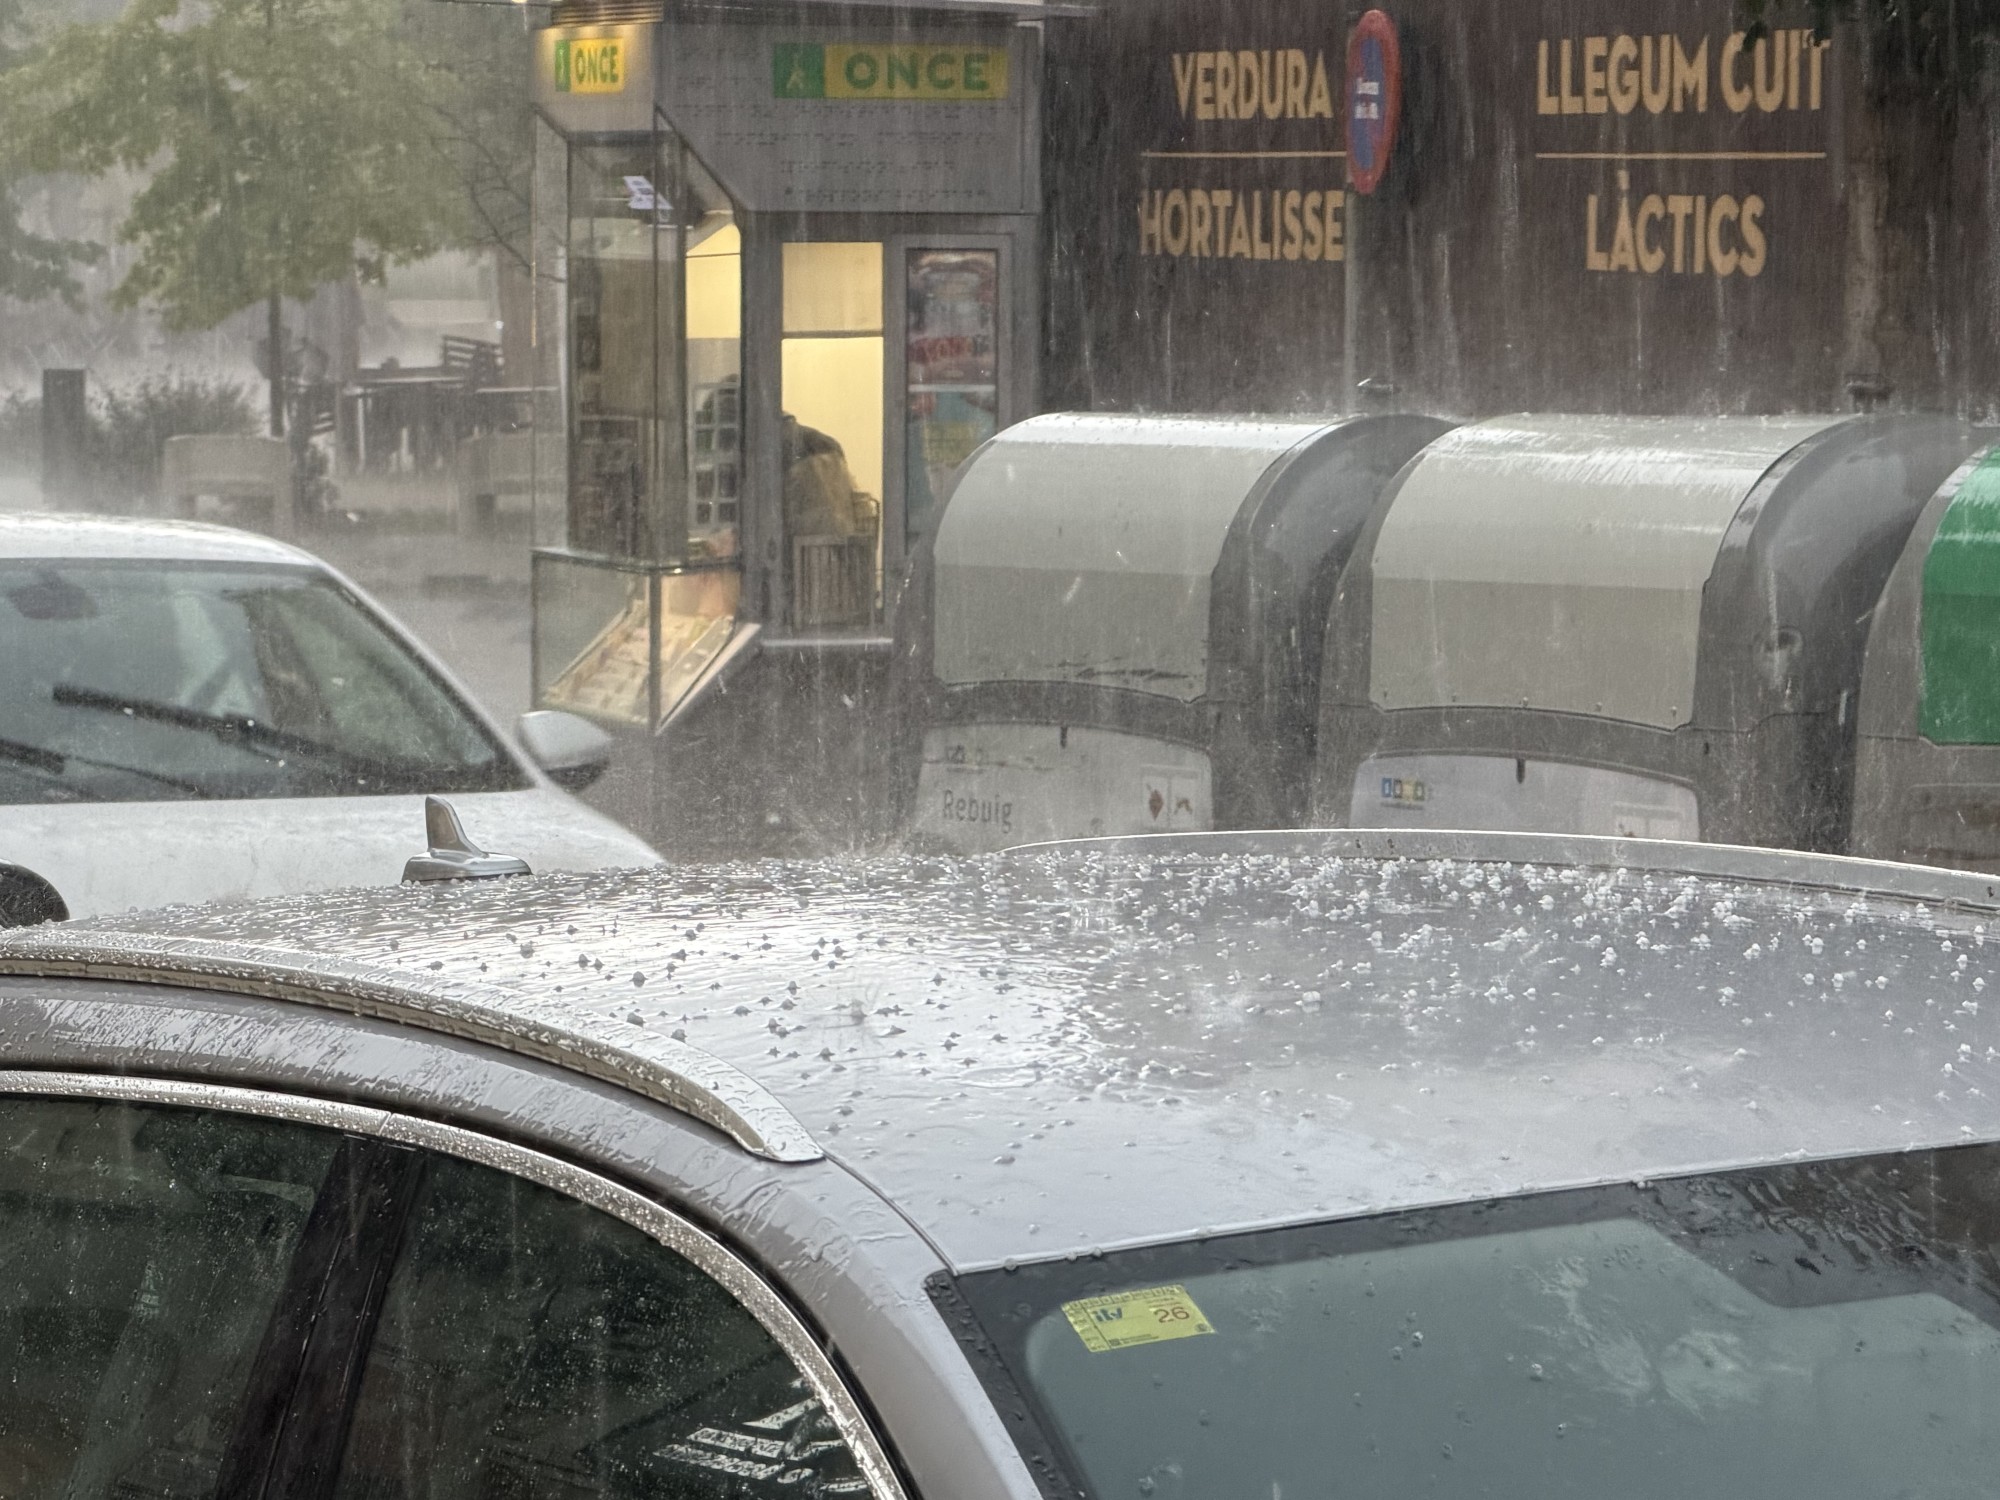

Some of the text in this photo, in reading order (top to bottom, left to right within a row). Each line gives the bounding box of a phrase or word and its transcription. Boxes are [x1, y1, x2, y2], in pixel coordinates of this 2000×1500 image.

[574, 46, 619, 84] ONCE
[845, 52, 989, 91] ONCE
[1172, 49, 1334, 120] VERDURA
[1537, 28, 1831, 115] LLEGUM CUIT
[943, 789, 1013, 834] Rebuig
[1154, 1306, 1190, 1324] 26
